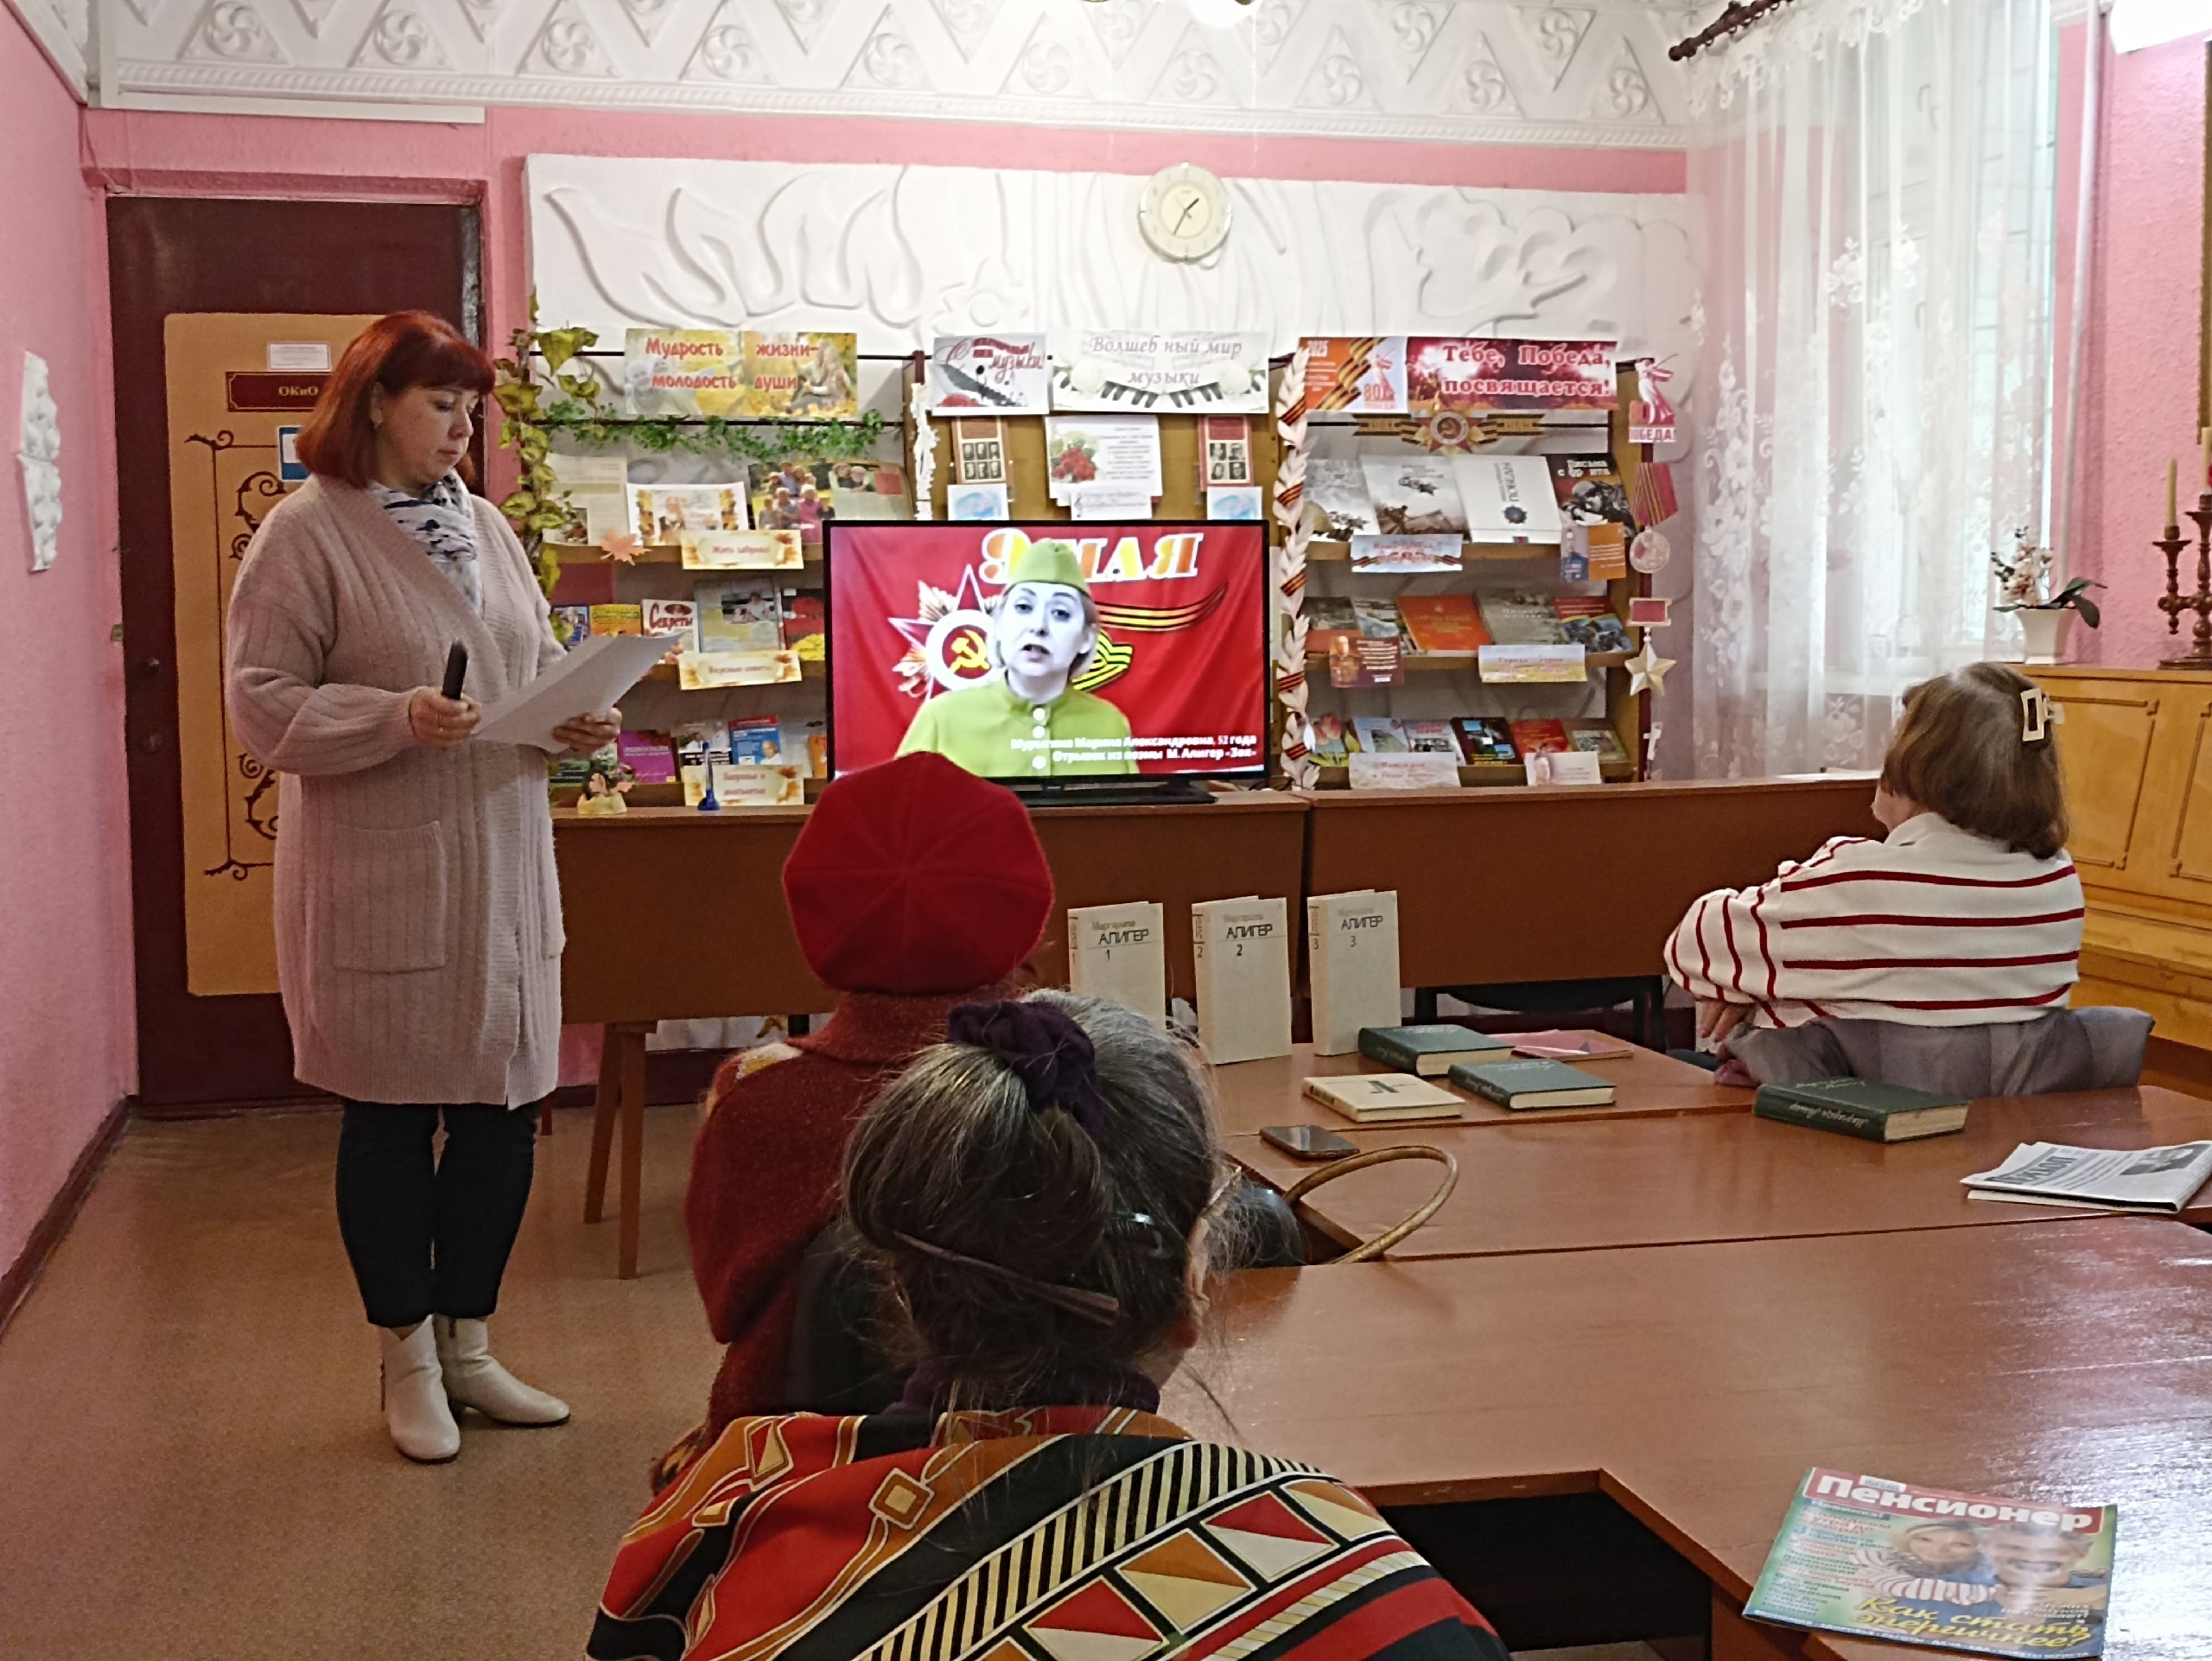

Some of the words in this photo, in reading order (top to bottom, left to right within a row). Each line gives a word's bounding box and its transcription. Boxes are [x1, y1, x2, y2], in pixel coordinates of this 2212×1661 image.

[645, 337, 723, 360] Мудрость
[1089, 336, 1158, 354] Волшеб
[1166, 337, 1198, 355] ный
[1205, 343, 1242, 360] мир
[1443, 346, 1505, 369] Тебе,
[1518, 346, 1611, 367] Победа,
[652, 374, 736, 391] молодость
[754, 376, 797, 393] души
[1127, 369, 1201, 386] музыки
[1441, 379, 1610, 397] посвящается!
[1230, 735, 1257, 746] года
[1182, 748, 1224, 760] Алигер
[1341, 915, 1382, 930] АЛИГЕР
[1098, 928, 1148, 945] АЛИГЕР
[1227, 924, 1273, 939] АЛИГЕР
[1313, 939, 1319, 950] 3
[1350, 935, 1357, 947] 3
[1105, 949, 1110, 961] 1
[1198, 946, 1203, 958] 2
[1236, 944, 1243, 956] 2
[1817, 1474, 2092, 1531] Пенсионер
[1857, 1598, 1939, 1620] Как
[1950, 1614, 2088, 1636] стать
